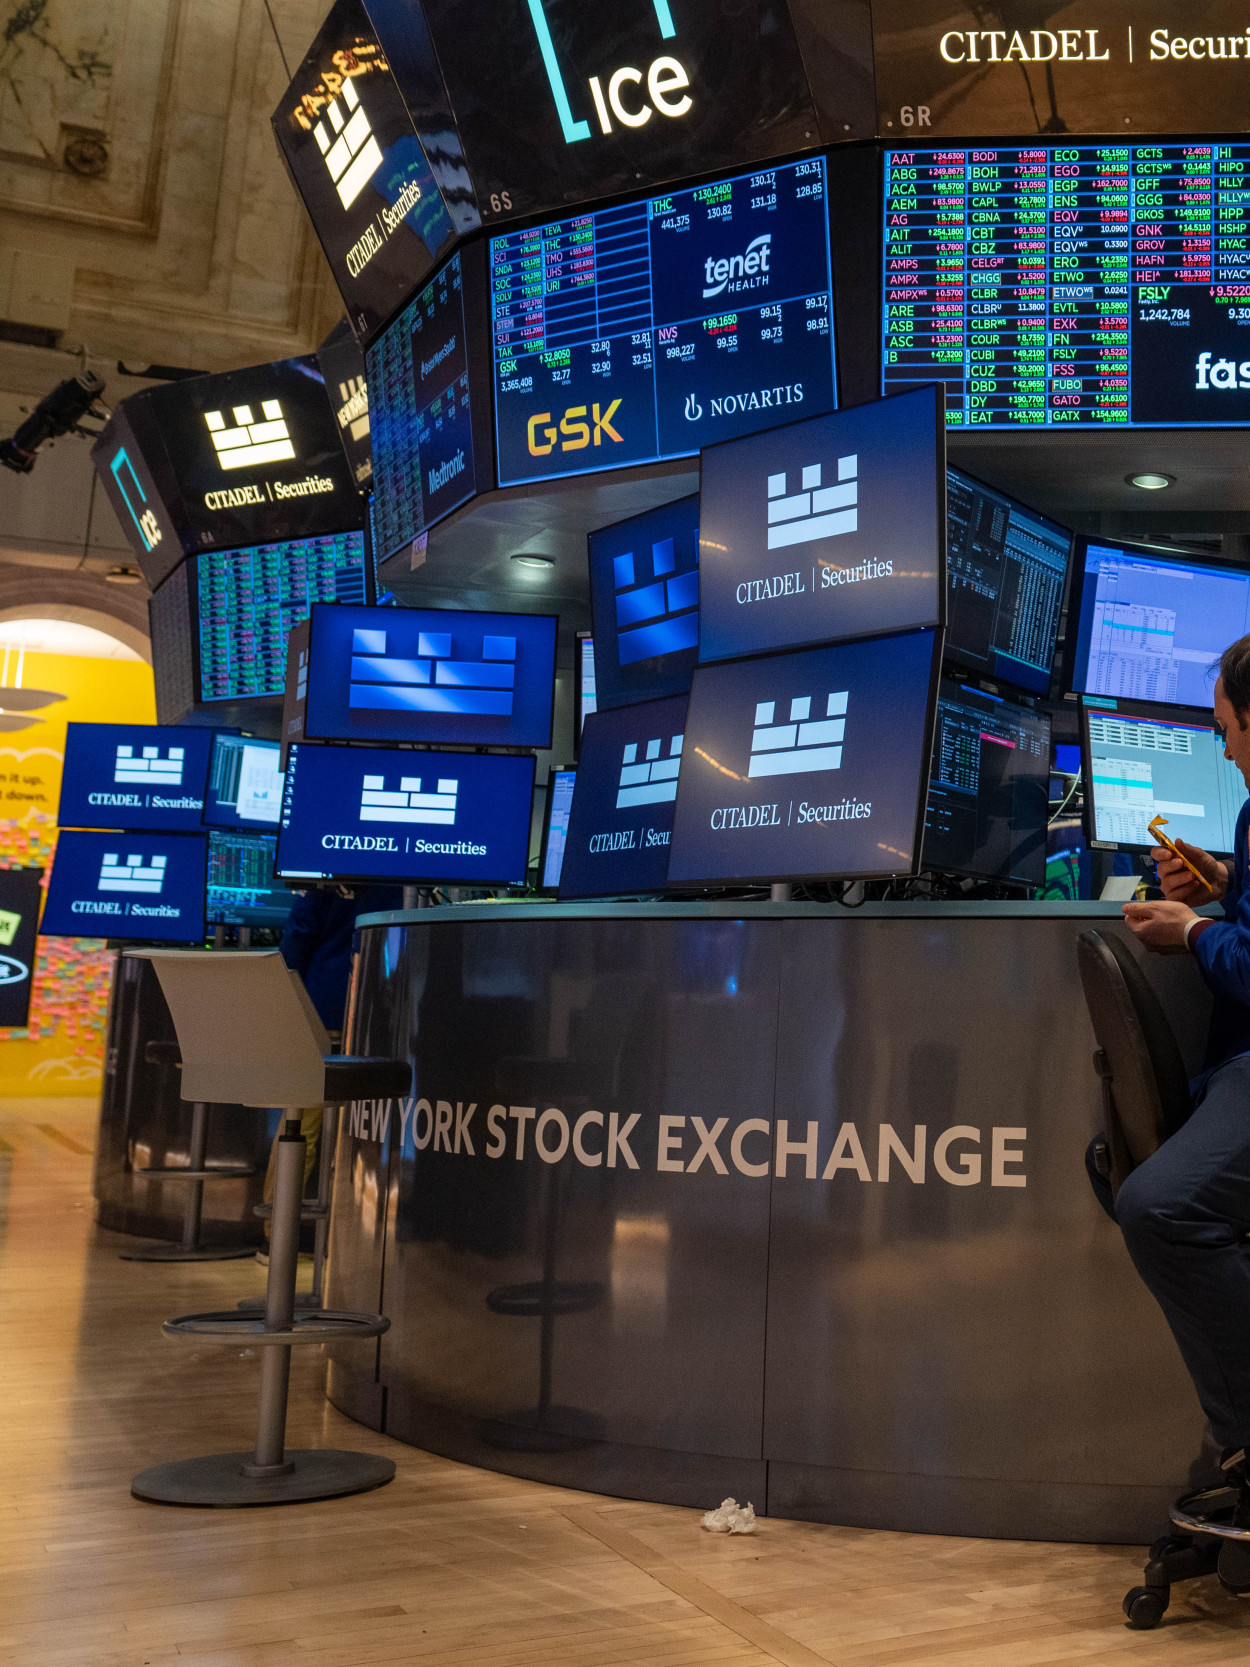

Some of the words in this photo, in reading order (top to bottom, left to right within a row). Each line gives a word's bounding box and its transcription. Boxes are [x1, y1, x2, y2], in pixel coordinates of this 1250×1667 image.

[940, 30, 1109, 62] CITADEL
[900, 106, 931, 126] 6R
[892, 153, 915, 164] AAT
[973, 152, 997, 161] BODI
[1055, 150, 1079, 161] ECO
[1136, 148, 1162, 158] GCTS
[1219, 148, 1231, 158] HI
[973, 168, 999, 178] BOH
[654, 200, 672, 211] THC
[698, 183, 732, 201] 130.2400
[751, 173, 775, 188] 130.17
[795, 161, 821, 176] 130.31
[490, 191, 513, 214] 6S
[662, 214, 689, 231] 441,375
[707, 204, 732, 219] 130.82
[751, 193, 776, 209] 131.18
[796, 183, 822, 198] 128.85
[346, 224, 382, 278] CITADEL
[382, 180, 421, 234] Securities
[704, 242, 771, 285] tenet
[728, 275, 769, 293] HEALTH
[1139, 287, 1170, 300] FSLY
[658, 326, 678, 340] NVS
[708, 314, 737, 330] 99.1650
[760, 306, 782, 318] 99.15
[806, 295, 827, 309] 99.17
[1140, 309, 1190, 320] 1,242,784
[1229, 308, 1250, 319] 9.30
[666, 344, 695, 359] 998,227
[717, 336, 738, 349] 99.55
[761, 327, 782, 340] 99.73
[807, 317, 828, 331] 98.91
[500, 360, 517, 373] GSK
[544, 348, 571, 364] 32.8050
[591, 340, 610, 353] 32.80
[632, 332, 651, 345] 32.81
[971, 381, 996, 392] DBD
[711, 383, 804, 417] NOVARTIS
[527, 398, 624, 456] GSK
[971, 412, 993, 422] EAT
[1053, 411, 1080, 421] GATX
[429, 448, 465, 495] Medtronic
[205, 485, 265, 510] CITADEL
[274, 475, 333, 499] Securities
[736, 571, 805, 604] CITADEL
[821, 557, 893, 589] Securities
[88, 793, 141, 807] CITADEL
[152, 796, 203, 809] Securities
[711, 804, 780, 830] CITADEL
[797, 797, 871, 824] Securities
[322, 835, 398, 852] CITADEL
[415, 839, 486, 856] Securities
[589, 830, 635, 853] CITADEL
[72, 901, 121, 915] CITADEL
[131, 904, 180, 917] Securities
[349, 1098, 392, 1144] NEW
[398, 1097, 477, 1156] YORK
[485, 1104, 642, 1171] STOCK
[656, 1114, 1029, 1189] EXCHANGE
